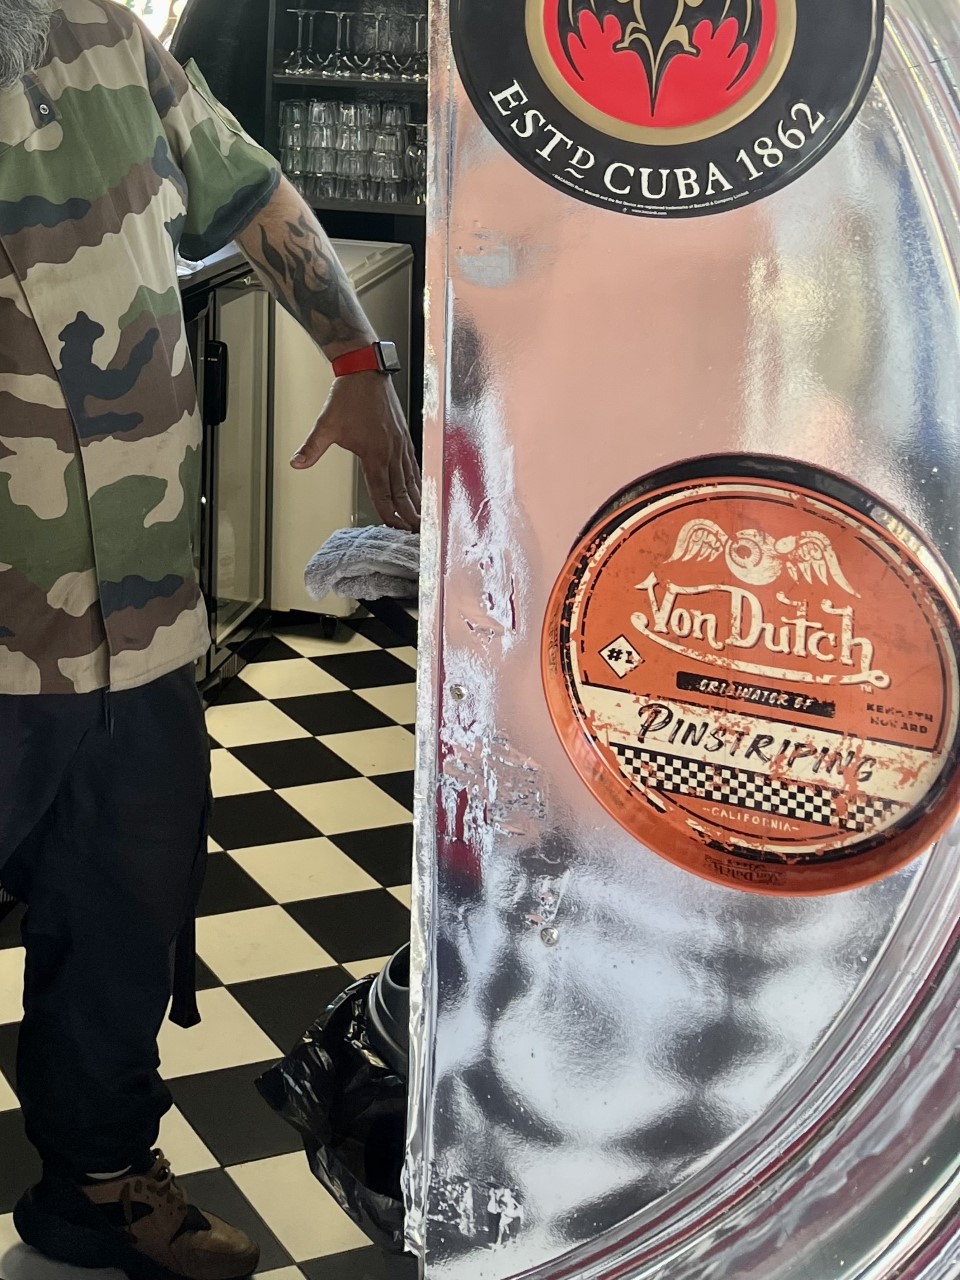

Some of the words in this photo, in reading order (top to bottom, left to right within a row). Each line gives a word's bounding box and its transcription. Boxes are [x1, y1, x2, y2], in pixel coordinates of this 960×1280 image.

[603, 162, 733, 200] CUBA
[735, 102, 826, 182] 1862
[607, 646, 637, 665] #1
[632, 572, 724, 651] Von
[725, 584, 886, 678] Dutch
[637, 702, 878, 784] PINSTRIPING
